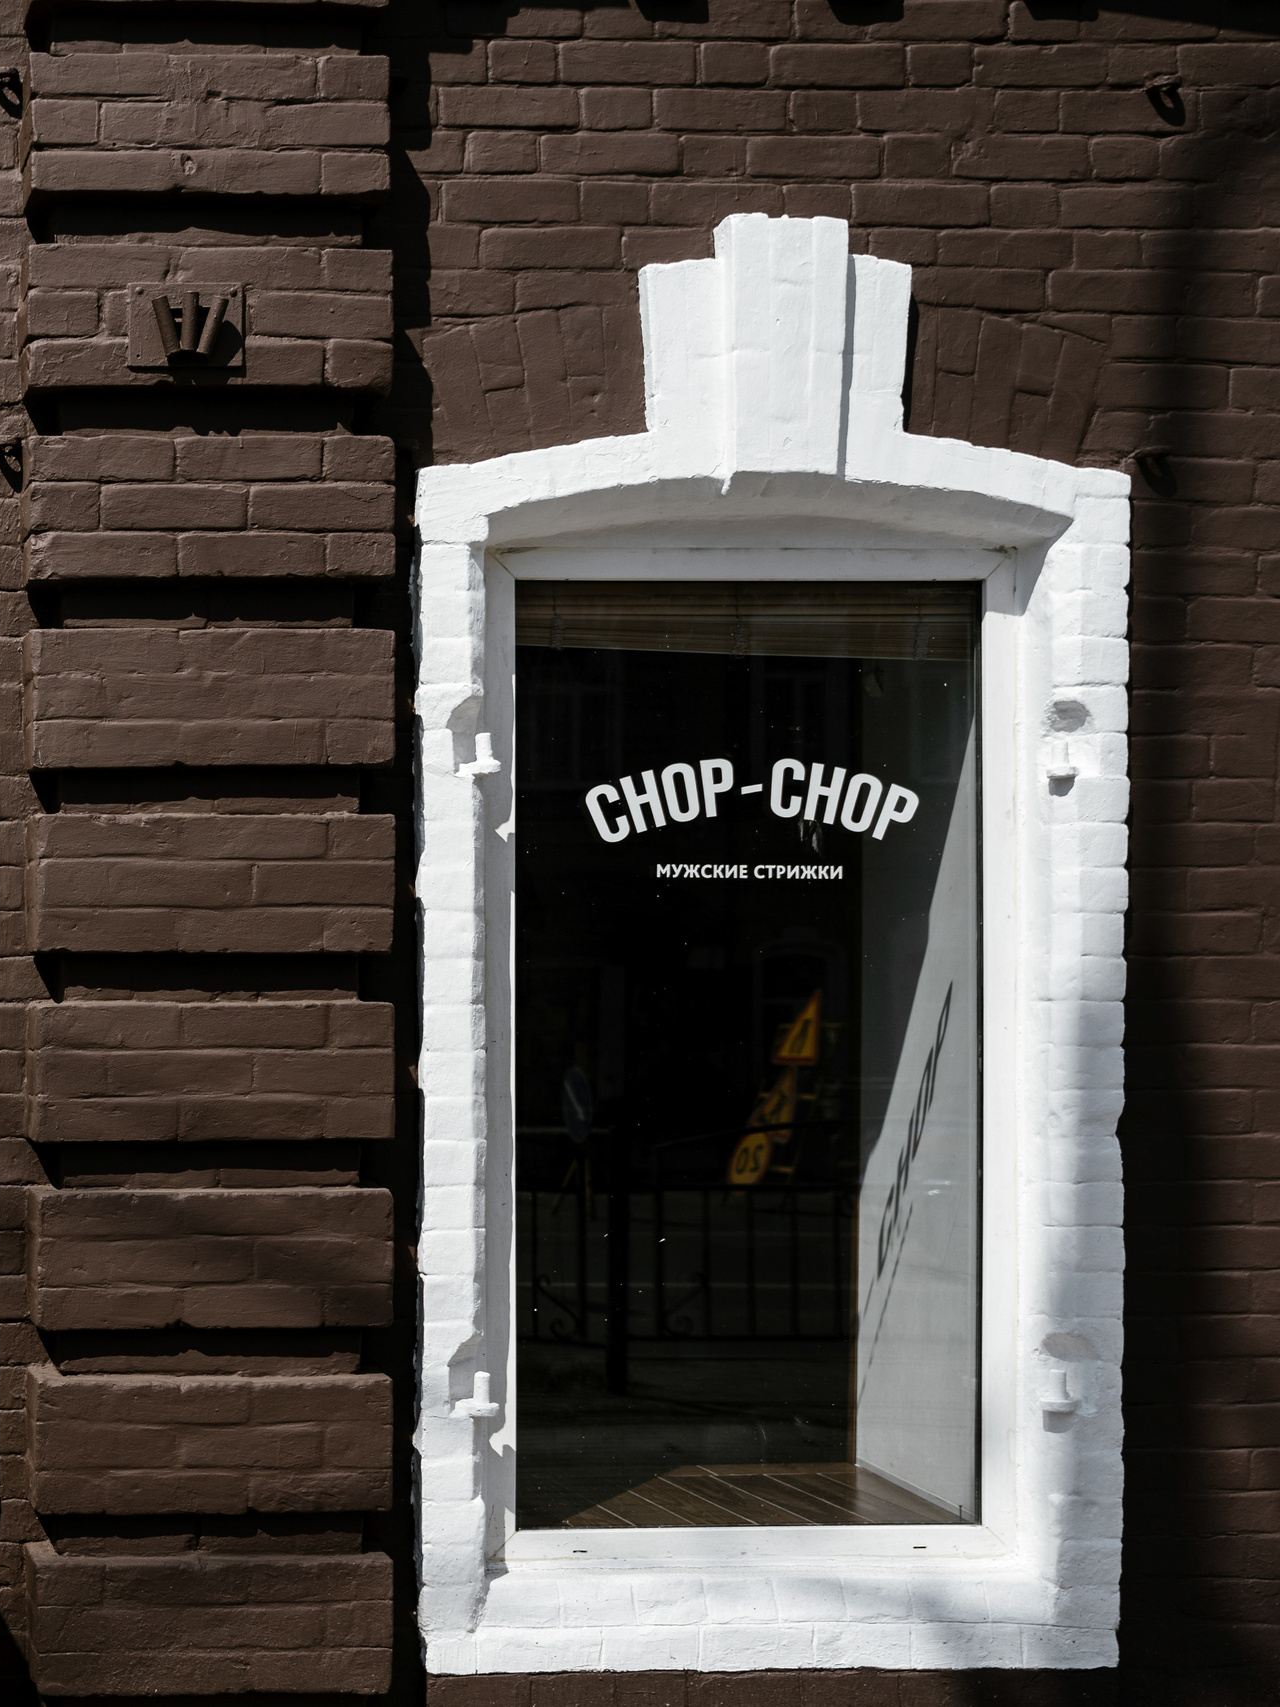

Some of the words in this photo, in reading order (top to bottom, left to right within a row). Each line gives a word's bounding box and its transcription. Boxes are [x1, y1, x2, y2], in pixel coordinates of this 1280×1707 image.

[586, 758, 919, 843] CHOP-CHOP
[656, 863, 749, 879] МУЖСКИЕ
[753, 864, 843, 880] СТРИЖКИ
